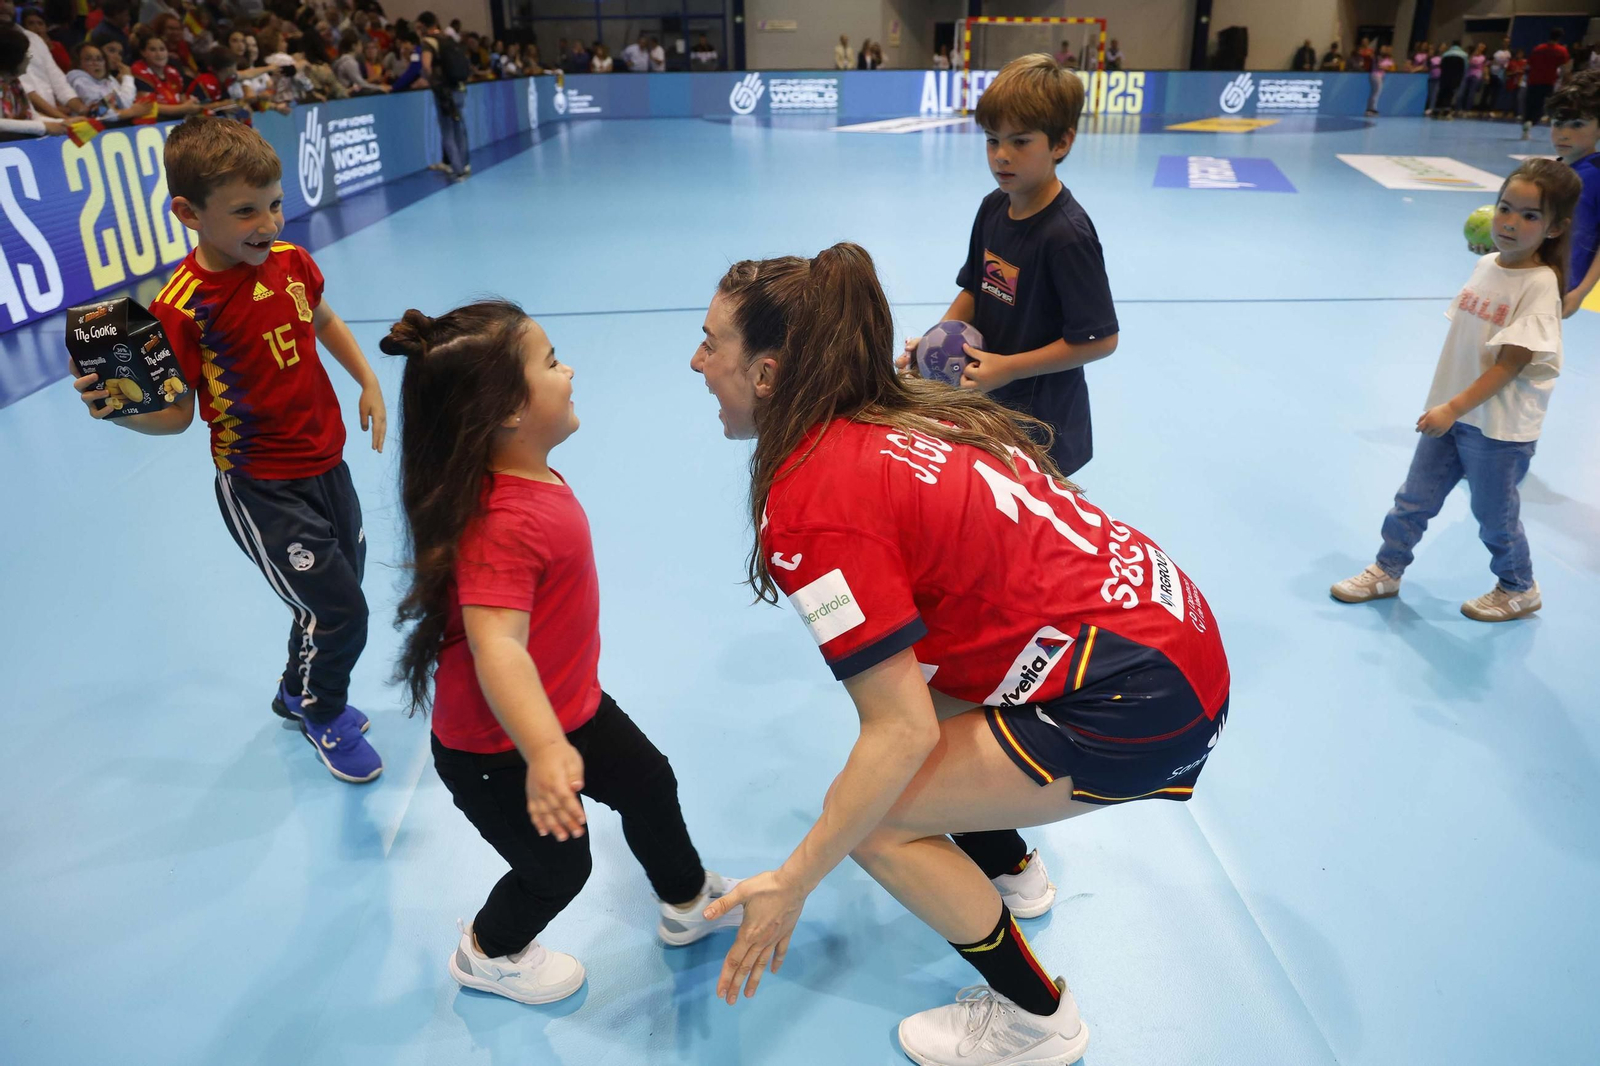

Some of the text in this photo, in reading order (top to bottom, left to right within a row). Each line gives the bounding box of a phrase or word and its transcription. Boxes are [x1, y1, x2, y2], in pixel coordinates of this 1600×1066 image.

[331, 141, 380, 170] WORLD
[61, 126, 199, 291] 202
[253, 290, 275, 301] adidas
[74, 323, 118, 343] The Cookie
[262, 323, 301, 370] 15
[881, 424, 955, 484] J.GU
